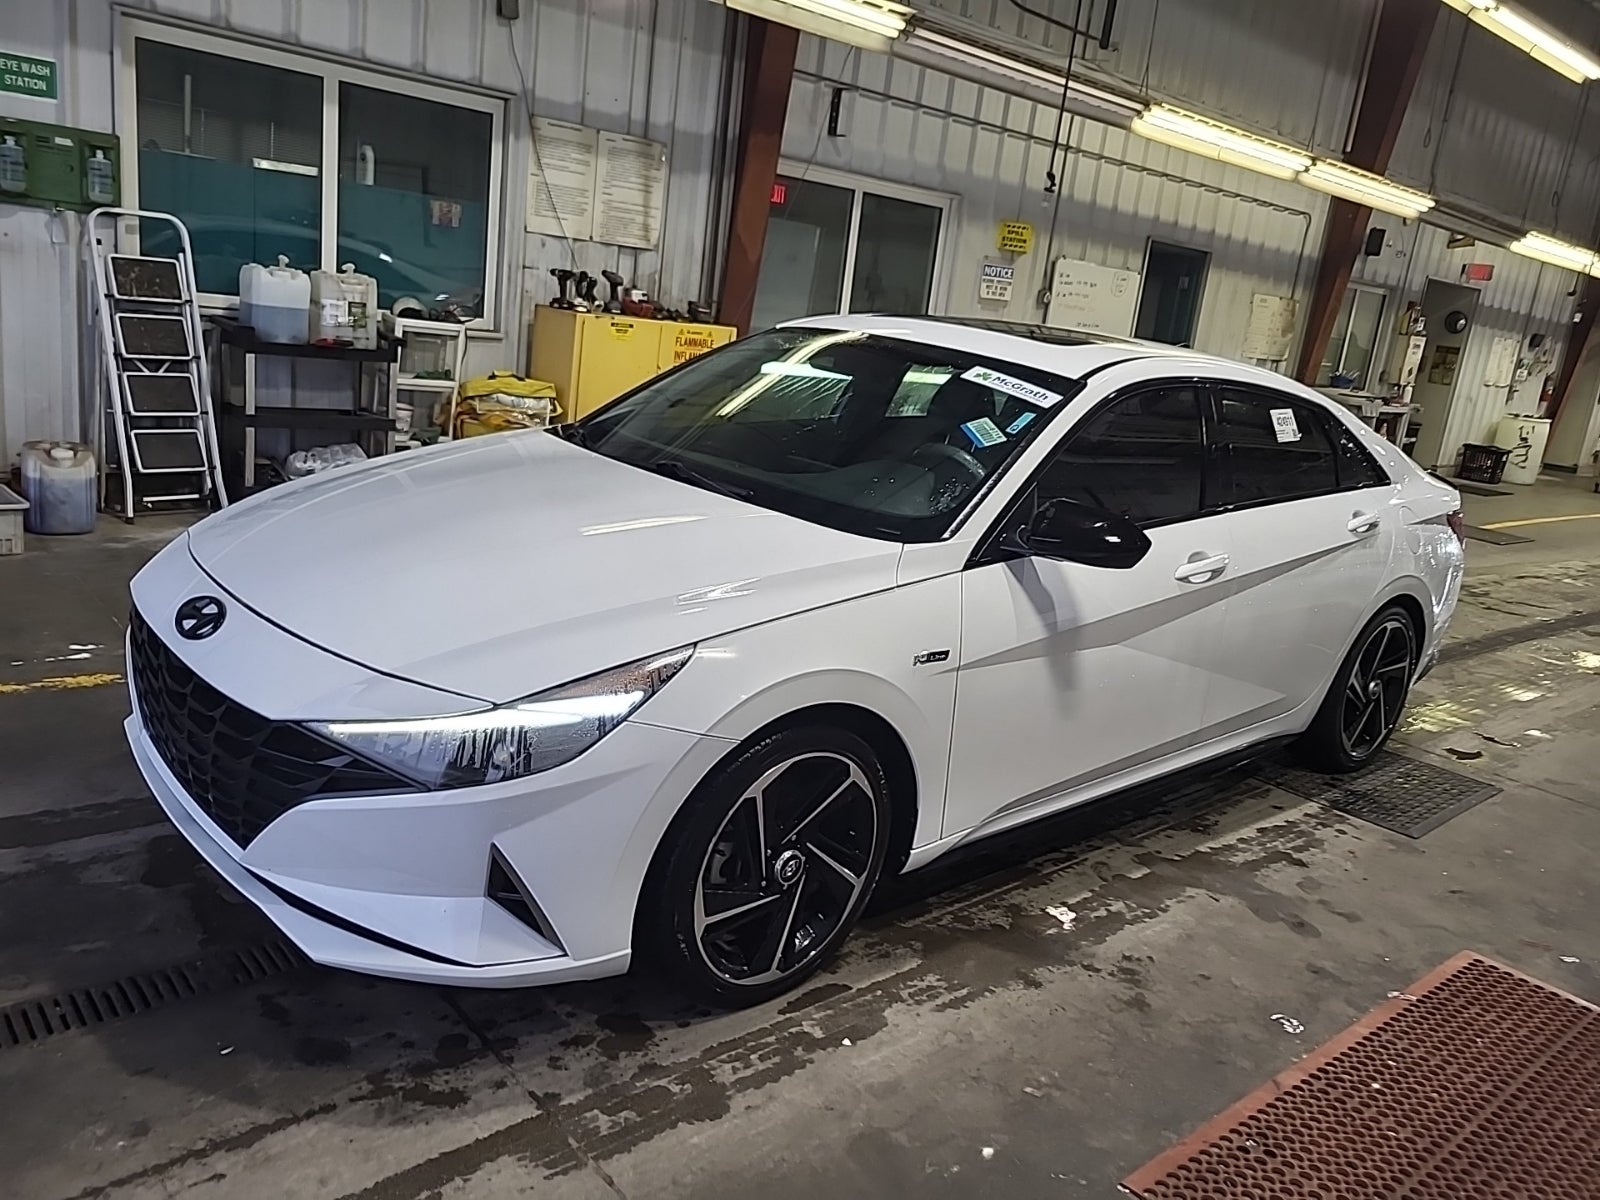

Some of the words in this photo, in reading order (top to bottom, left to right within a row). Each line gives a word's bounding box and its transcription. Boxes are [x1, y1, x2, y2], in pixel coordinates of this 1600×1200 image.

[0, 58, 19, 71] EYE
[20, 62, 50, 76] WASH
[4, 74, 47, 91] STATION
[770, 184, 786, 204] XIT
[1001, 235, 1028, 244] STATION
[1007, 229, 1024, 237] SPILL
[984, 265, 1014, 278] NOTICE
[675, 336, 715, 349] FLAMMABLE
[992, 376, 1049, 401] McGrath
